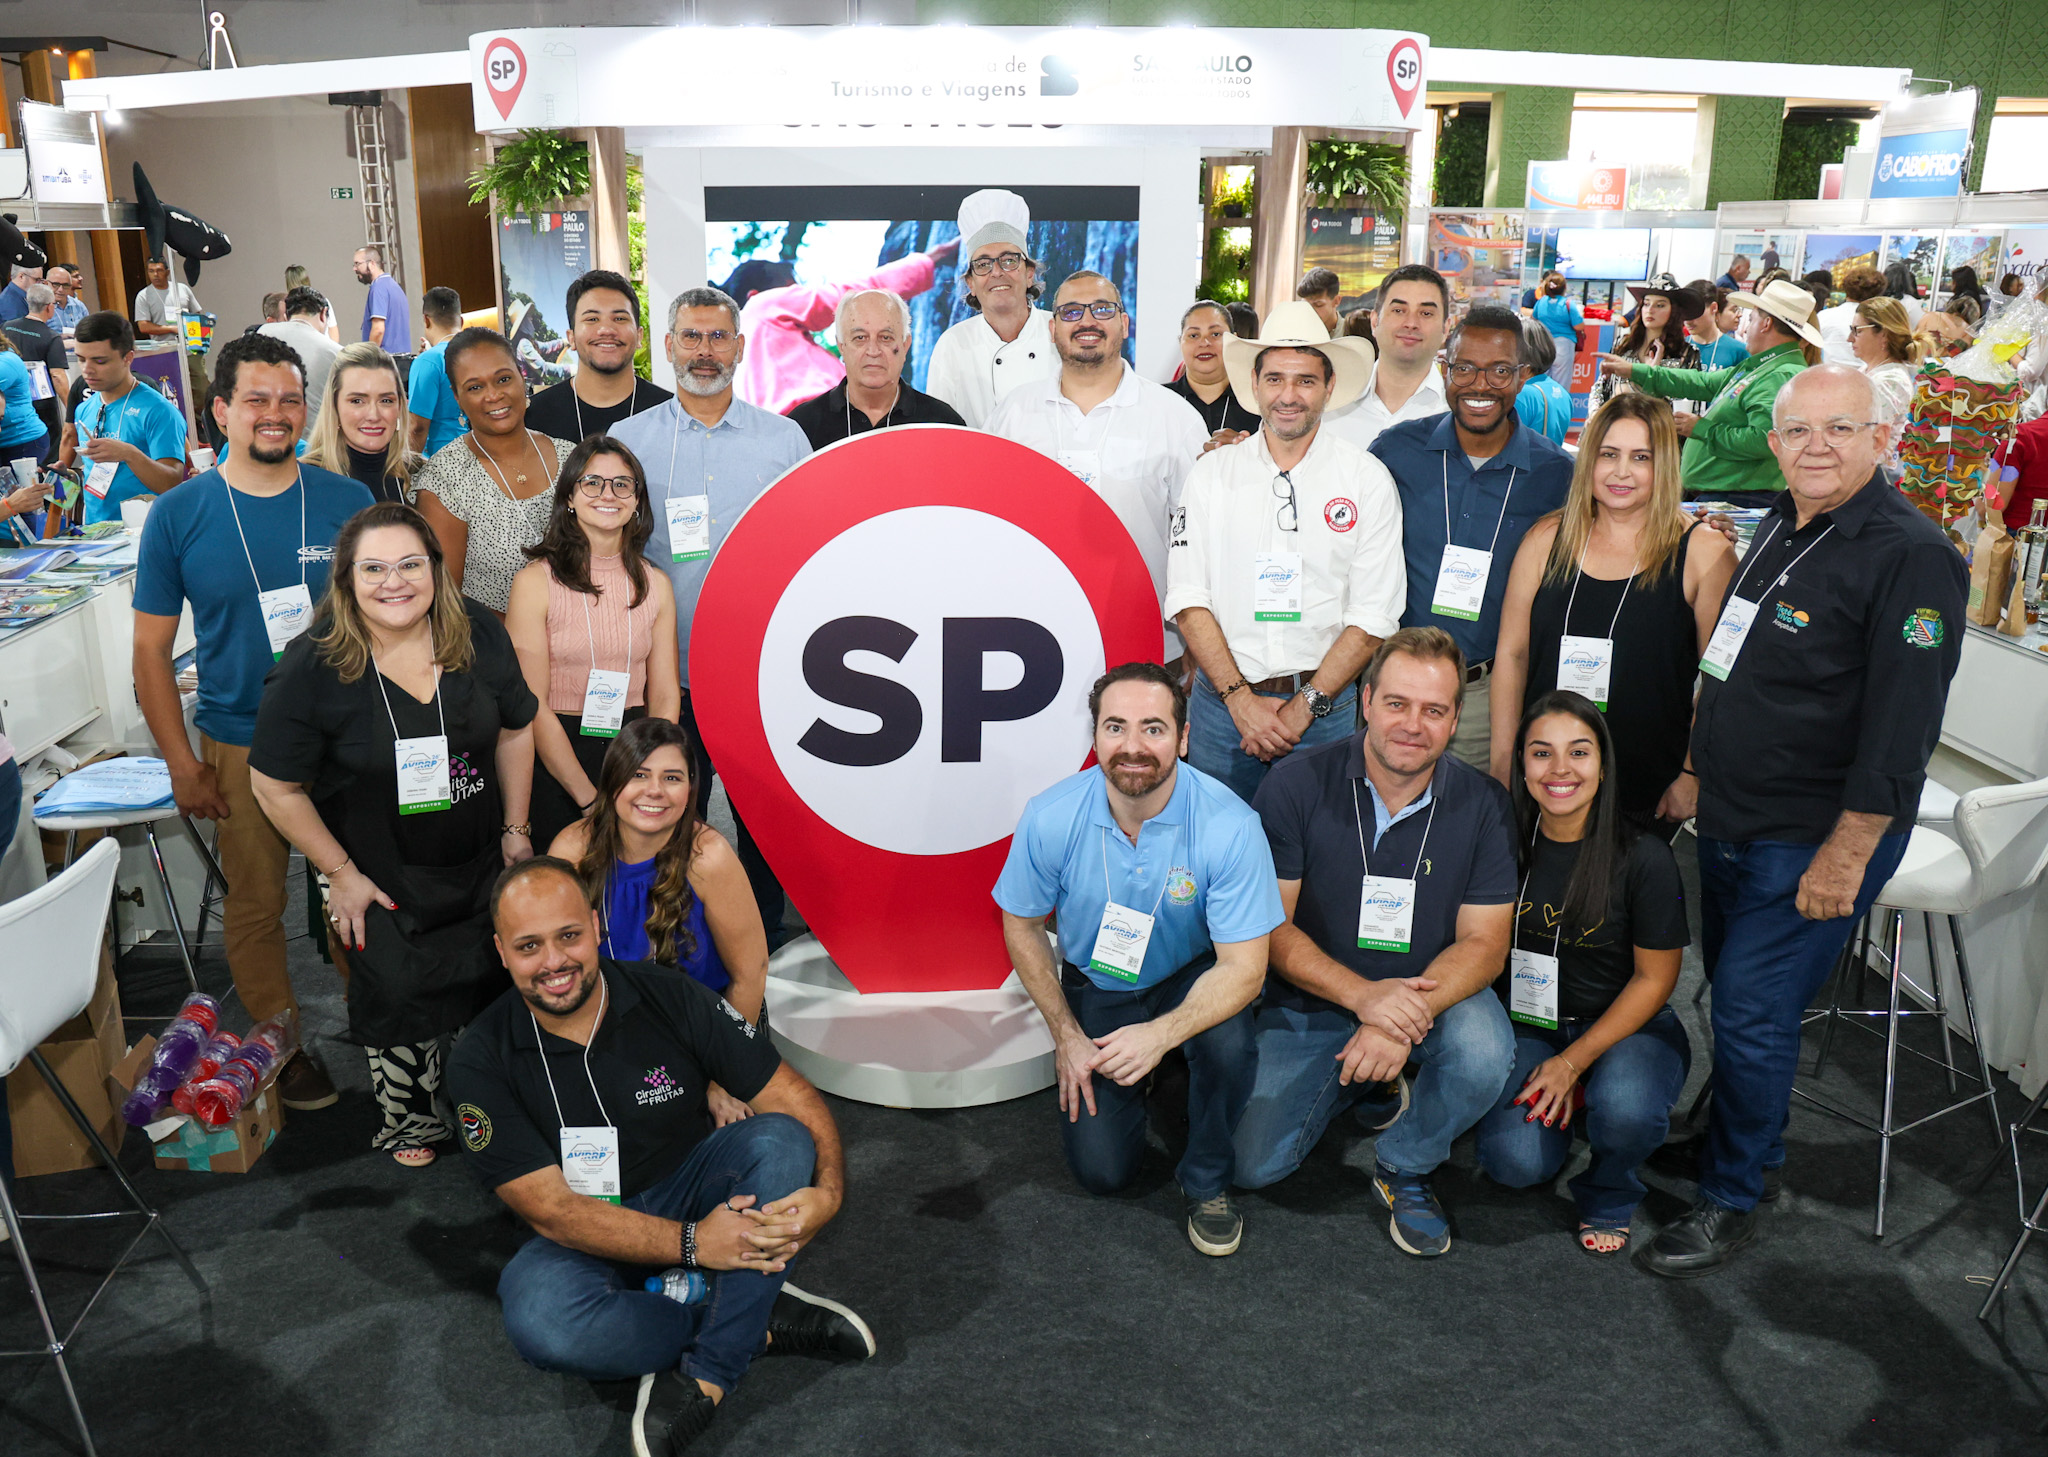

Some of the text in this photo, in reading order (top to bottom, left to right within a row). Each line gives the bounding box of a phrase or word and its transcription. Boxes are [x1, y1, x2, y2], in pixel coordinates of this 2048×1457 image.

[491, 59, 516, 81] SP
[1005, 55, 1027, 73] de
[1194, 54, 1253, 73] AULO
[1397, 59, 1417, 80] SP
[831, 81, 1027, 102] Turismo e Viagens
[1583, 193, 1620, 206] MALIBU
[563, 222, 585, 232] PAULO
[796, 615, 1064, 767] SP
[635, 1084, 672, 1100] Circuito
[649, 1087, 684, 1106] FRUTAS
